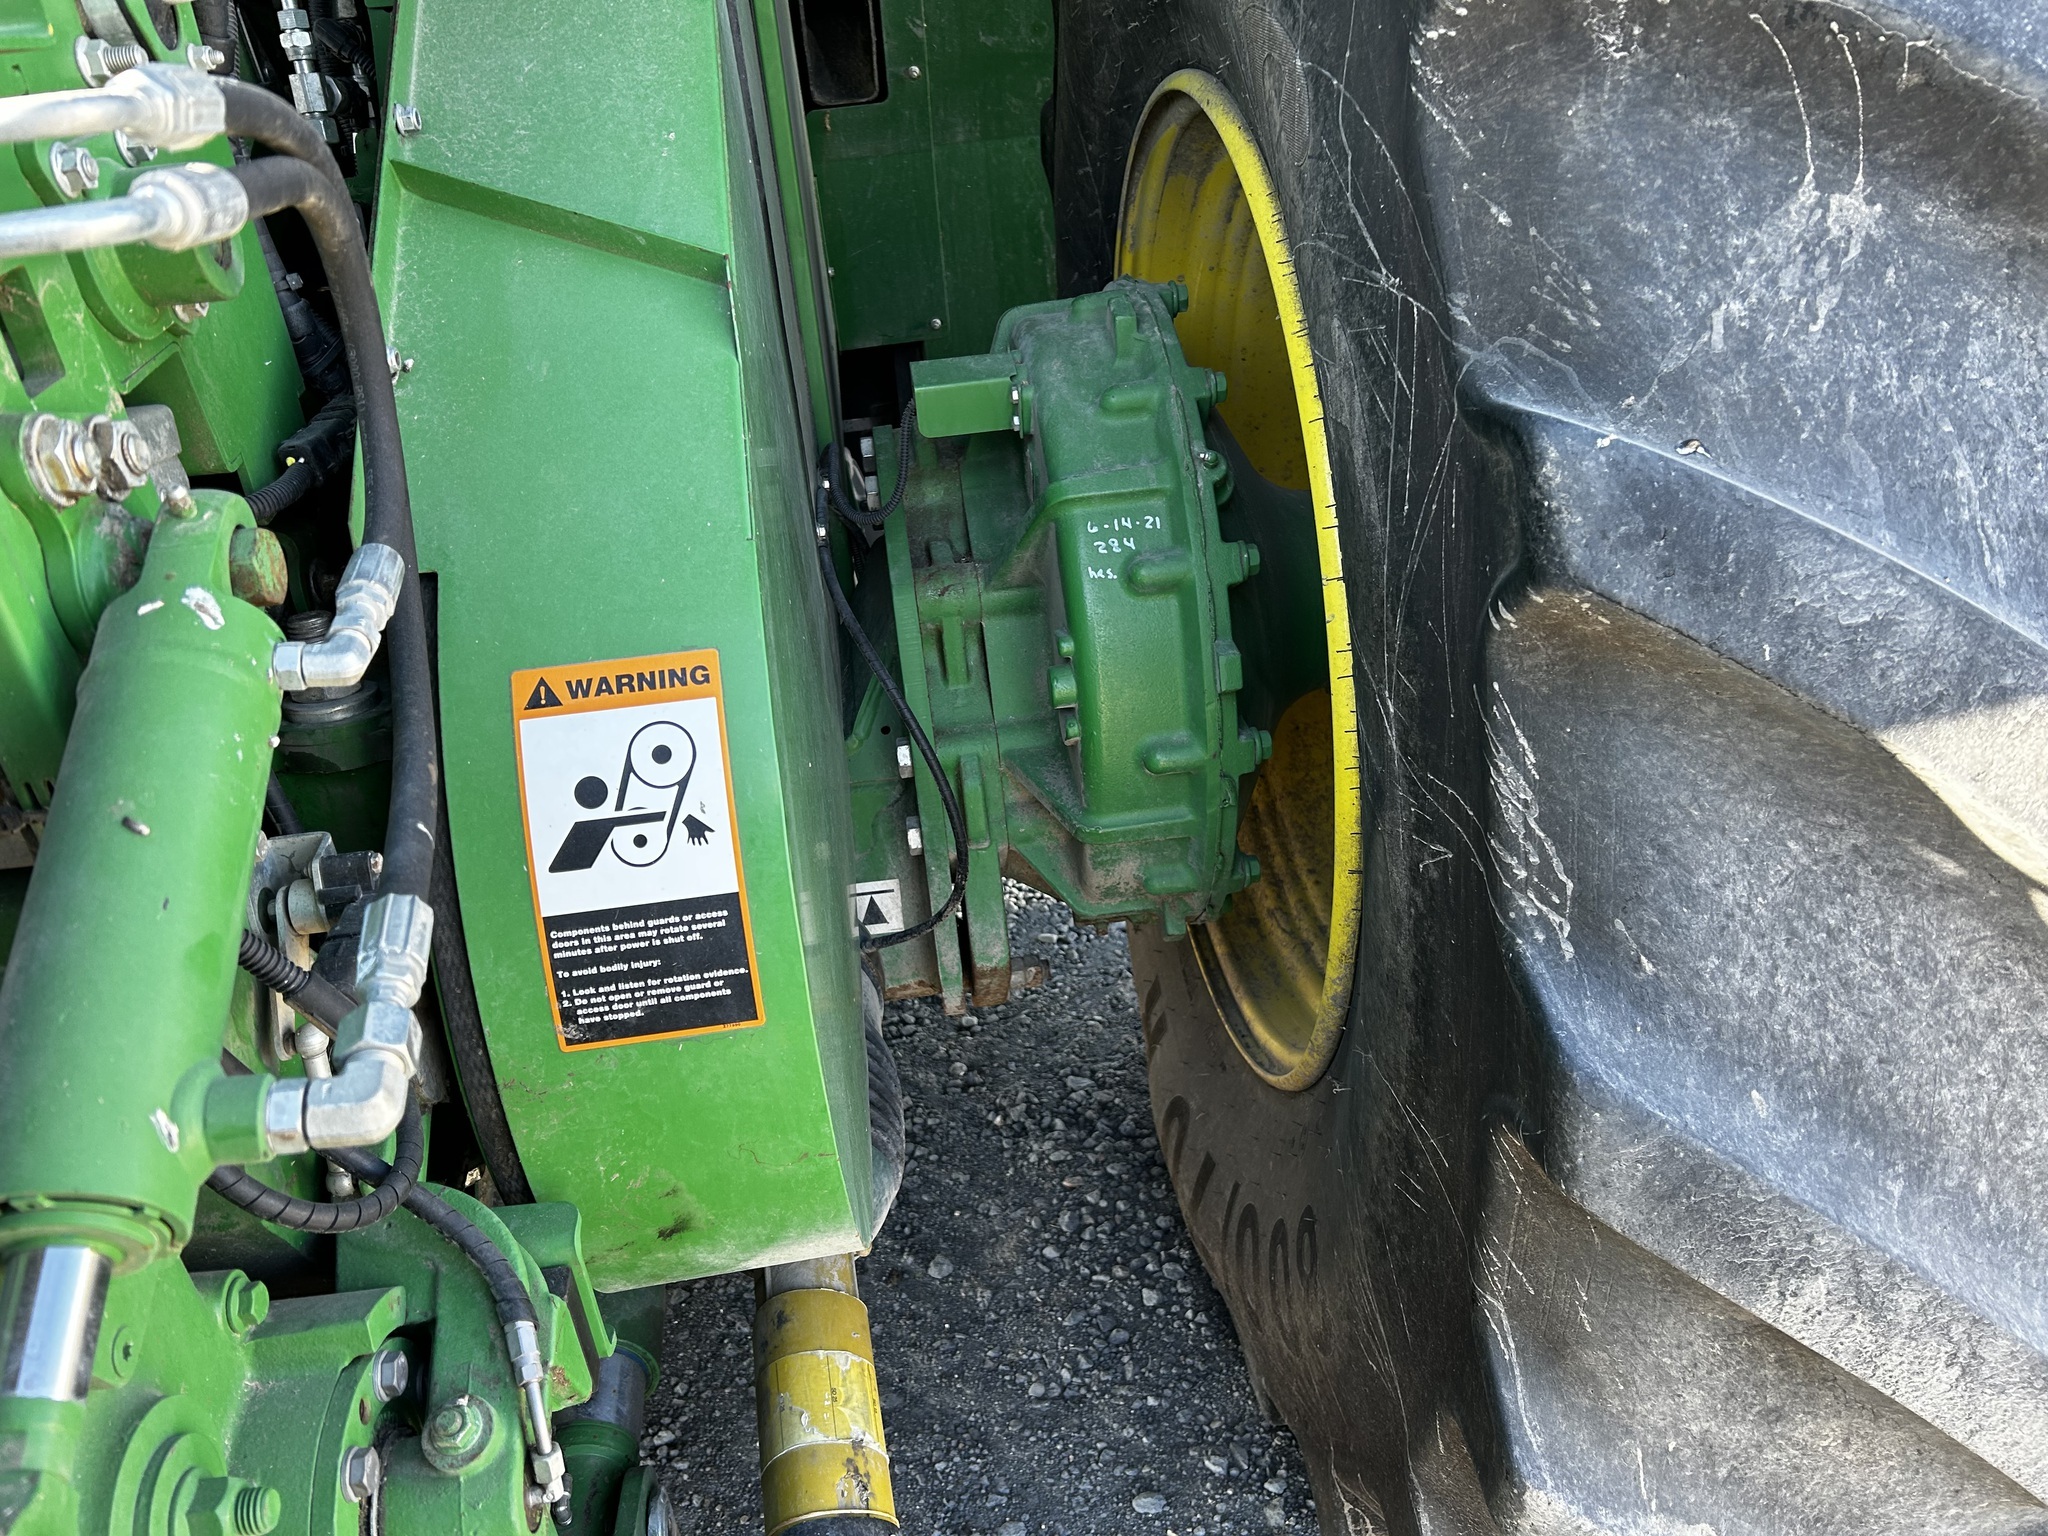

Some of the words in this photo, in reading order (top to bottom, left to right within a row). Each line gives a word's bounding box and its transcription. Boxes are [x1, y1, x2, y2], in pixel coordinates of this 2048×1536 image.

[1093, 537, 1136, 554] 284
[564, 665, 710, 699] WARNING
[550, 925, 610, 938] Components
[612, 919, 645, 930] behind
[647, 915, 680, 927] guards
[695, 909, 728, 920] access
[551, 939, 579, 948] doors
[581, 937, 591, 945] in
[593, 934, 612, 943] this
[614, 932, 635, 940] area
[637, 929, 657, 937] may
[659, 924, 689, 934] rotate
[691, 918, 726, 930] several
[553, 948, 592, 959] minutes
[594, 945, 618, 953] after
[620, 940, 650, 951] power
[651, 938, 661, 946] is
[663, 934, 685, 944] shut
[686, 932, 703, 941] off.
[556, 970, 569, 978] To
[572, 966, 597, 976] avoid
[599, 962, 628, 973] bodily
[630, 959, 661, 969] injury:
[572, 986, 596, 996] Look
[598, 983, 616, 993] and
[618, 981, 645, 990] listen
[647, 978, 661, 986] for
[663, 973, 701, 984] rotation
[703, 967, 748, 978] evidence.
[576, 1005, 610, 1015] access
[611, 1002, 633, 1010] door
[635, 997, 657, 1009] until
[660, 995, 672, 1004] all
[674, 988, 731, 1002] components
[590, 995, 606, 1003] not
[608, 992, 632, 1001] open
[646, 986, 682, 996] remove
[683, 980, 711, 992] guard
[578, 1016, 601, 1024] have
[603, 1009, 644, 1021] stopped.
